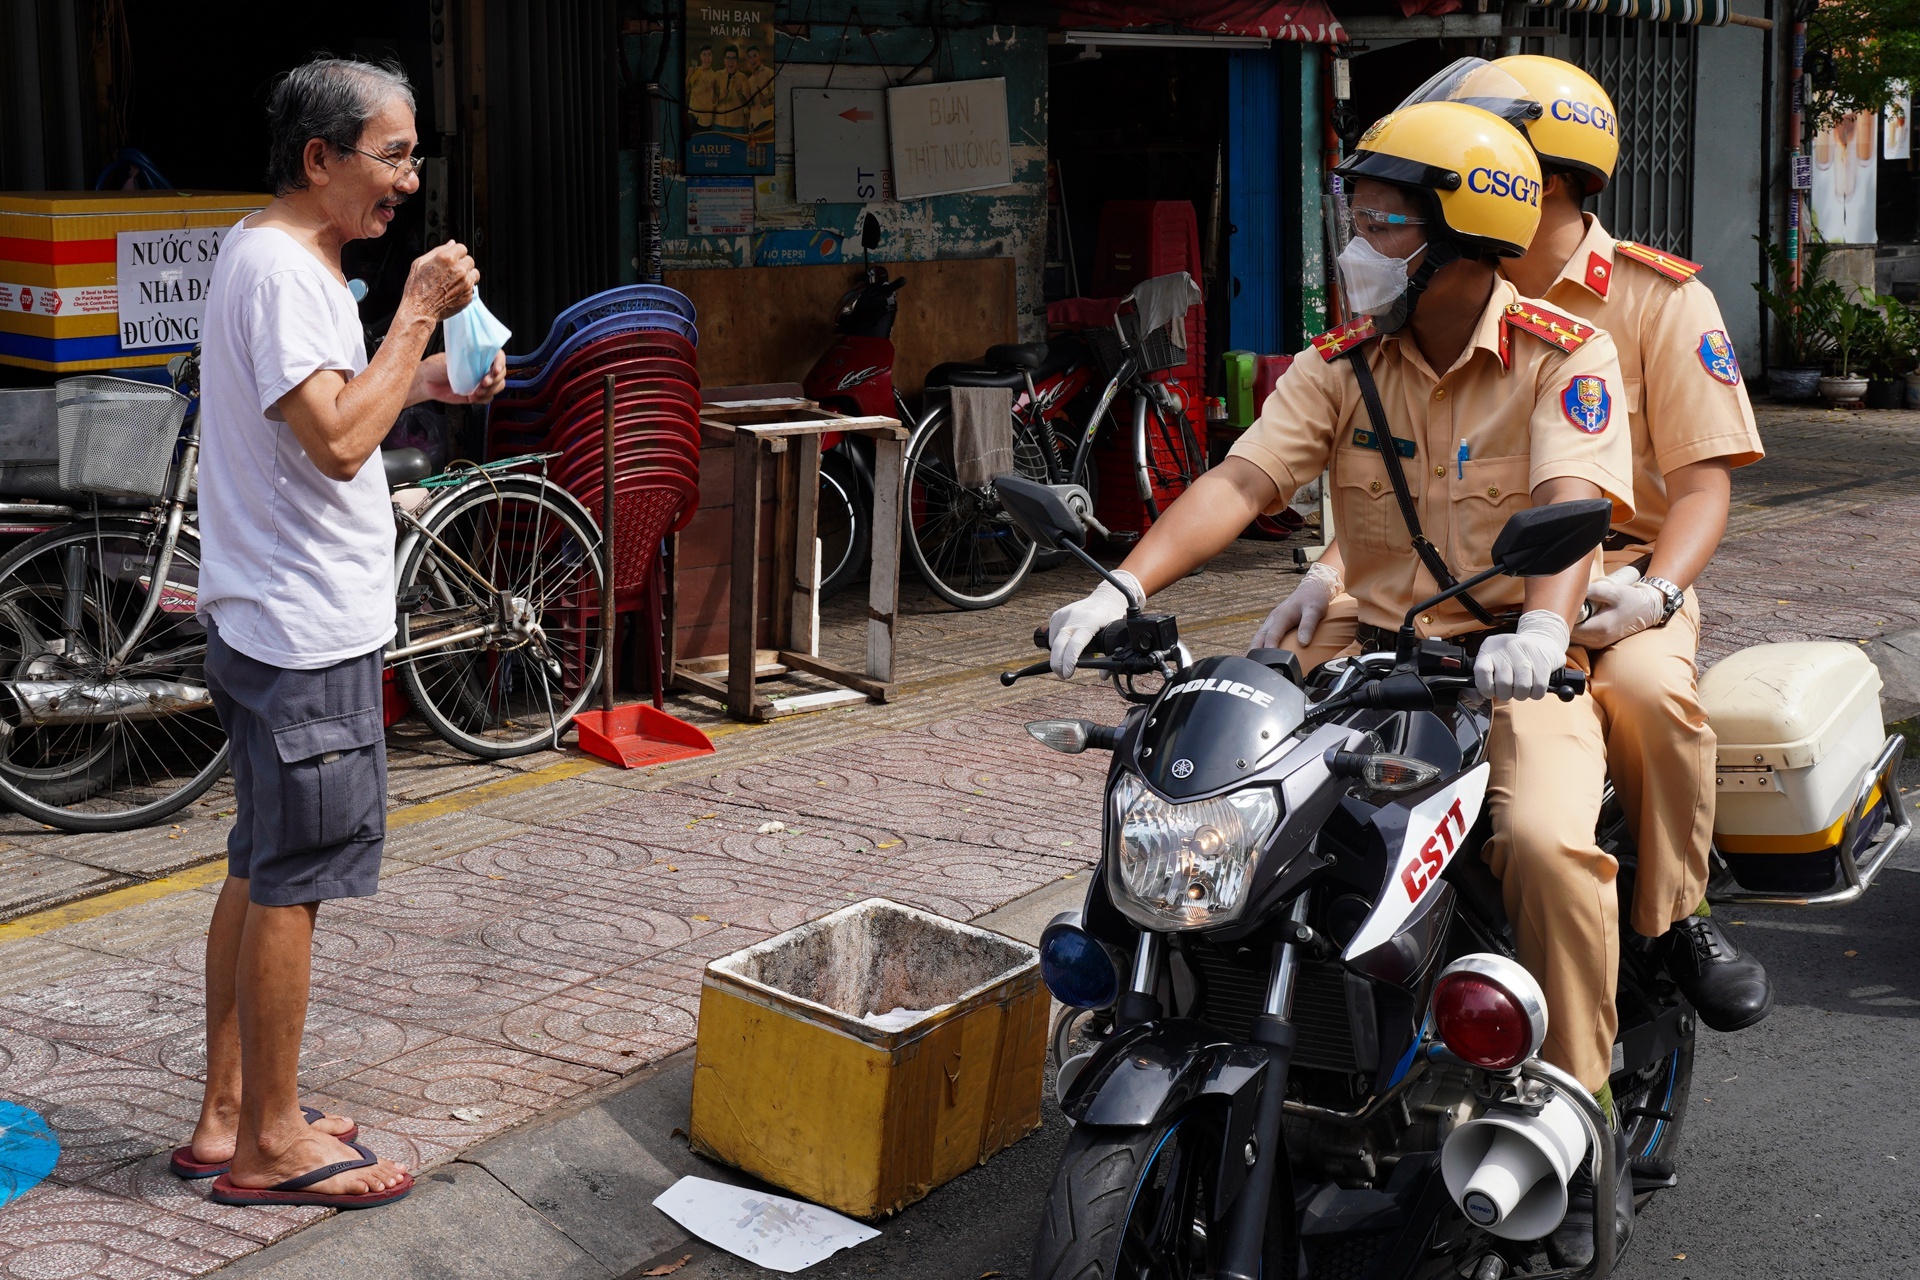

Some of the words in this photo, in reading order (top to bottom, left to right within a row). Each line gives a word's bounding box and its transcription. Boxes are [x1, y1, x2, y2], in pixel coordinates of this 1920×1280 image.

[700, 6, 730, 21] TÌNH
[734, 10, 760, 25] BẠN
[710, 24, 728, 36] MÃI
[732, 25, 750, 37] MÃI
[930, 86, 970, 126] BÚN
[1551, 99, 1616, 137] CSGT
[692, 144, 731, 154] LARUE
[858, 167, 875, 198] ST
[1468, 167, 1540, 207] CSGT
[132, 234, 192, 265] NƯỚC
[782, 250, 806, 258] PEPSI
[22, 295, 31, 304] STOP
[139, 280, 184, 304] NHA
[124, 312, 199, 345] ĐƯỜNG
[1164, 678, 1275, 709] POLICE
[1400, 797, 1466, 904] CSTT
